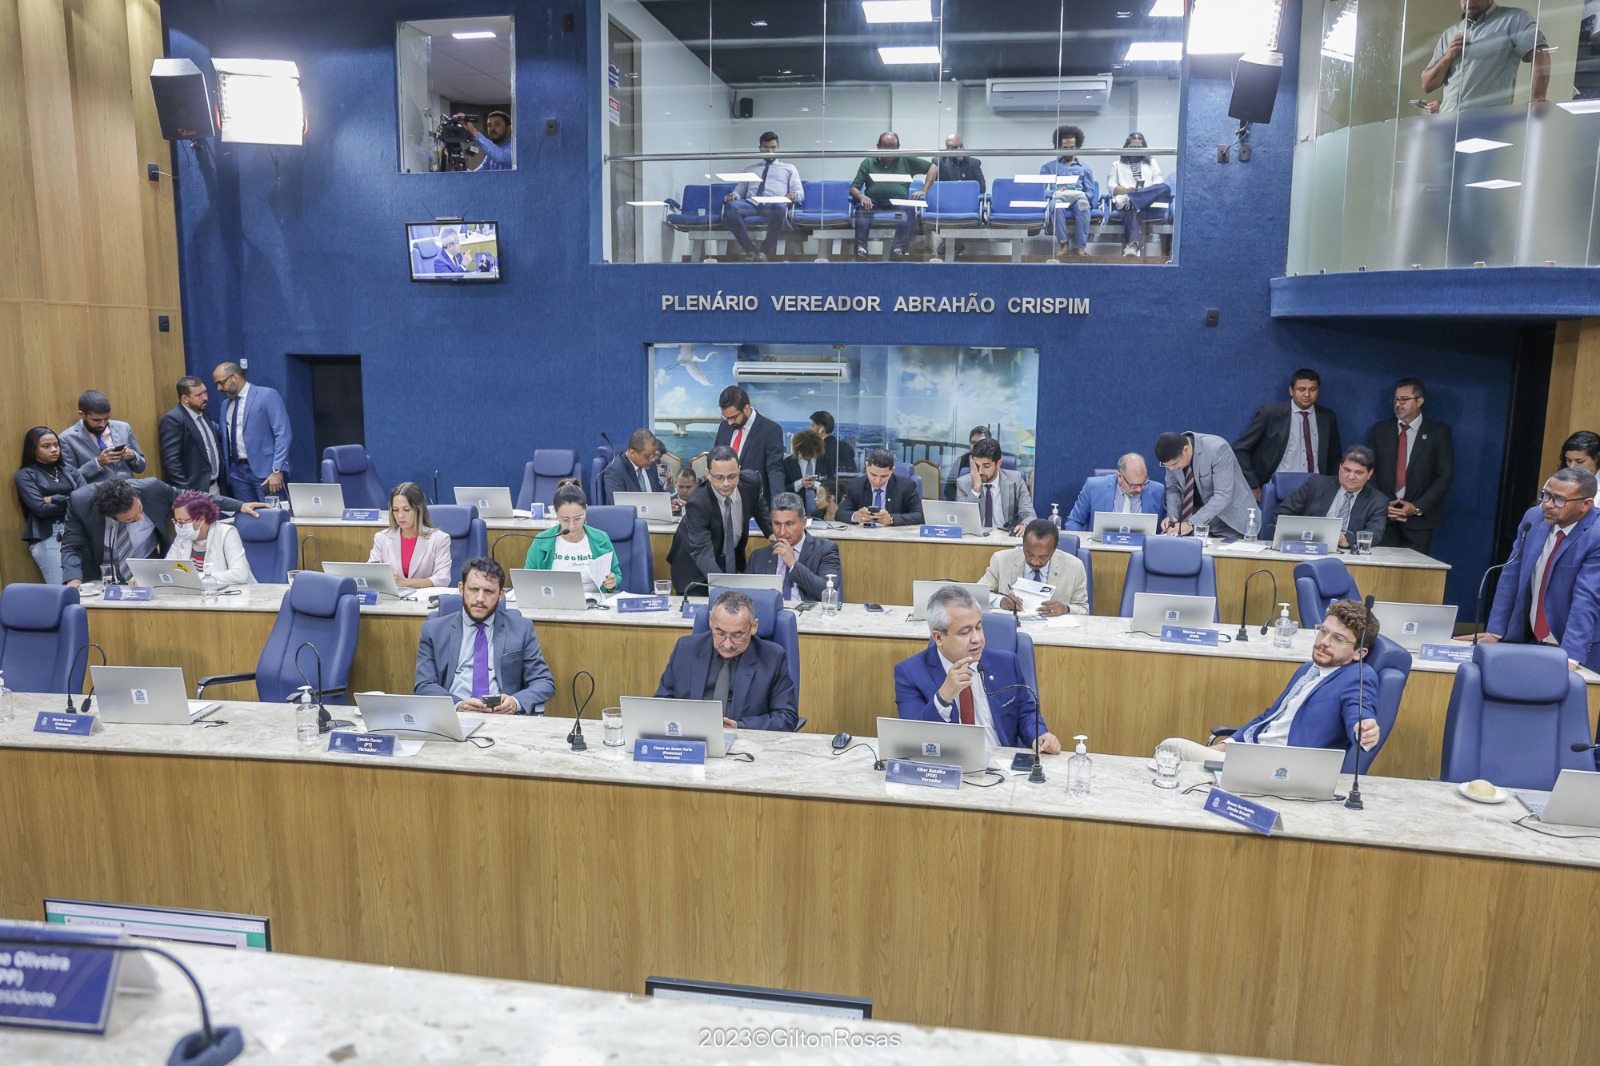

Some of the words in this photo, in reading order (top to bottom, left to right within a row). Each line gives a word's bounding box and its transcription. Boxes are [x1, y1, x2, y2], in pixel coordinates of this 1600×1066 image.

[661, 291, 759, 311] PLENÁRIO
[771, 295, 881, 312] VEREADOR
[893, 292, 995, 313] ABRAHÃO
[1007, 297, 1090, 314] CRISPIM
[0, 952, 13, 967] o
[13, 950, 71, 972] Oliveira
